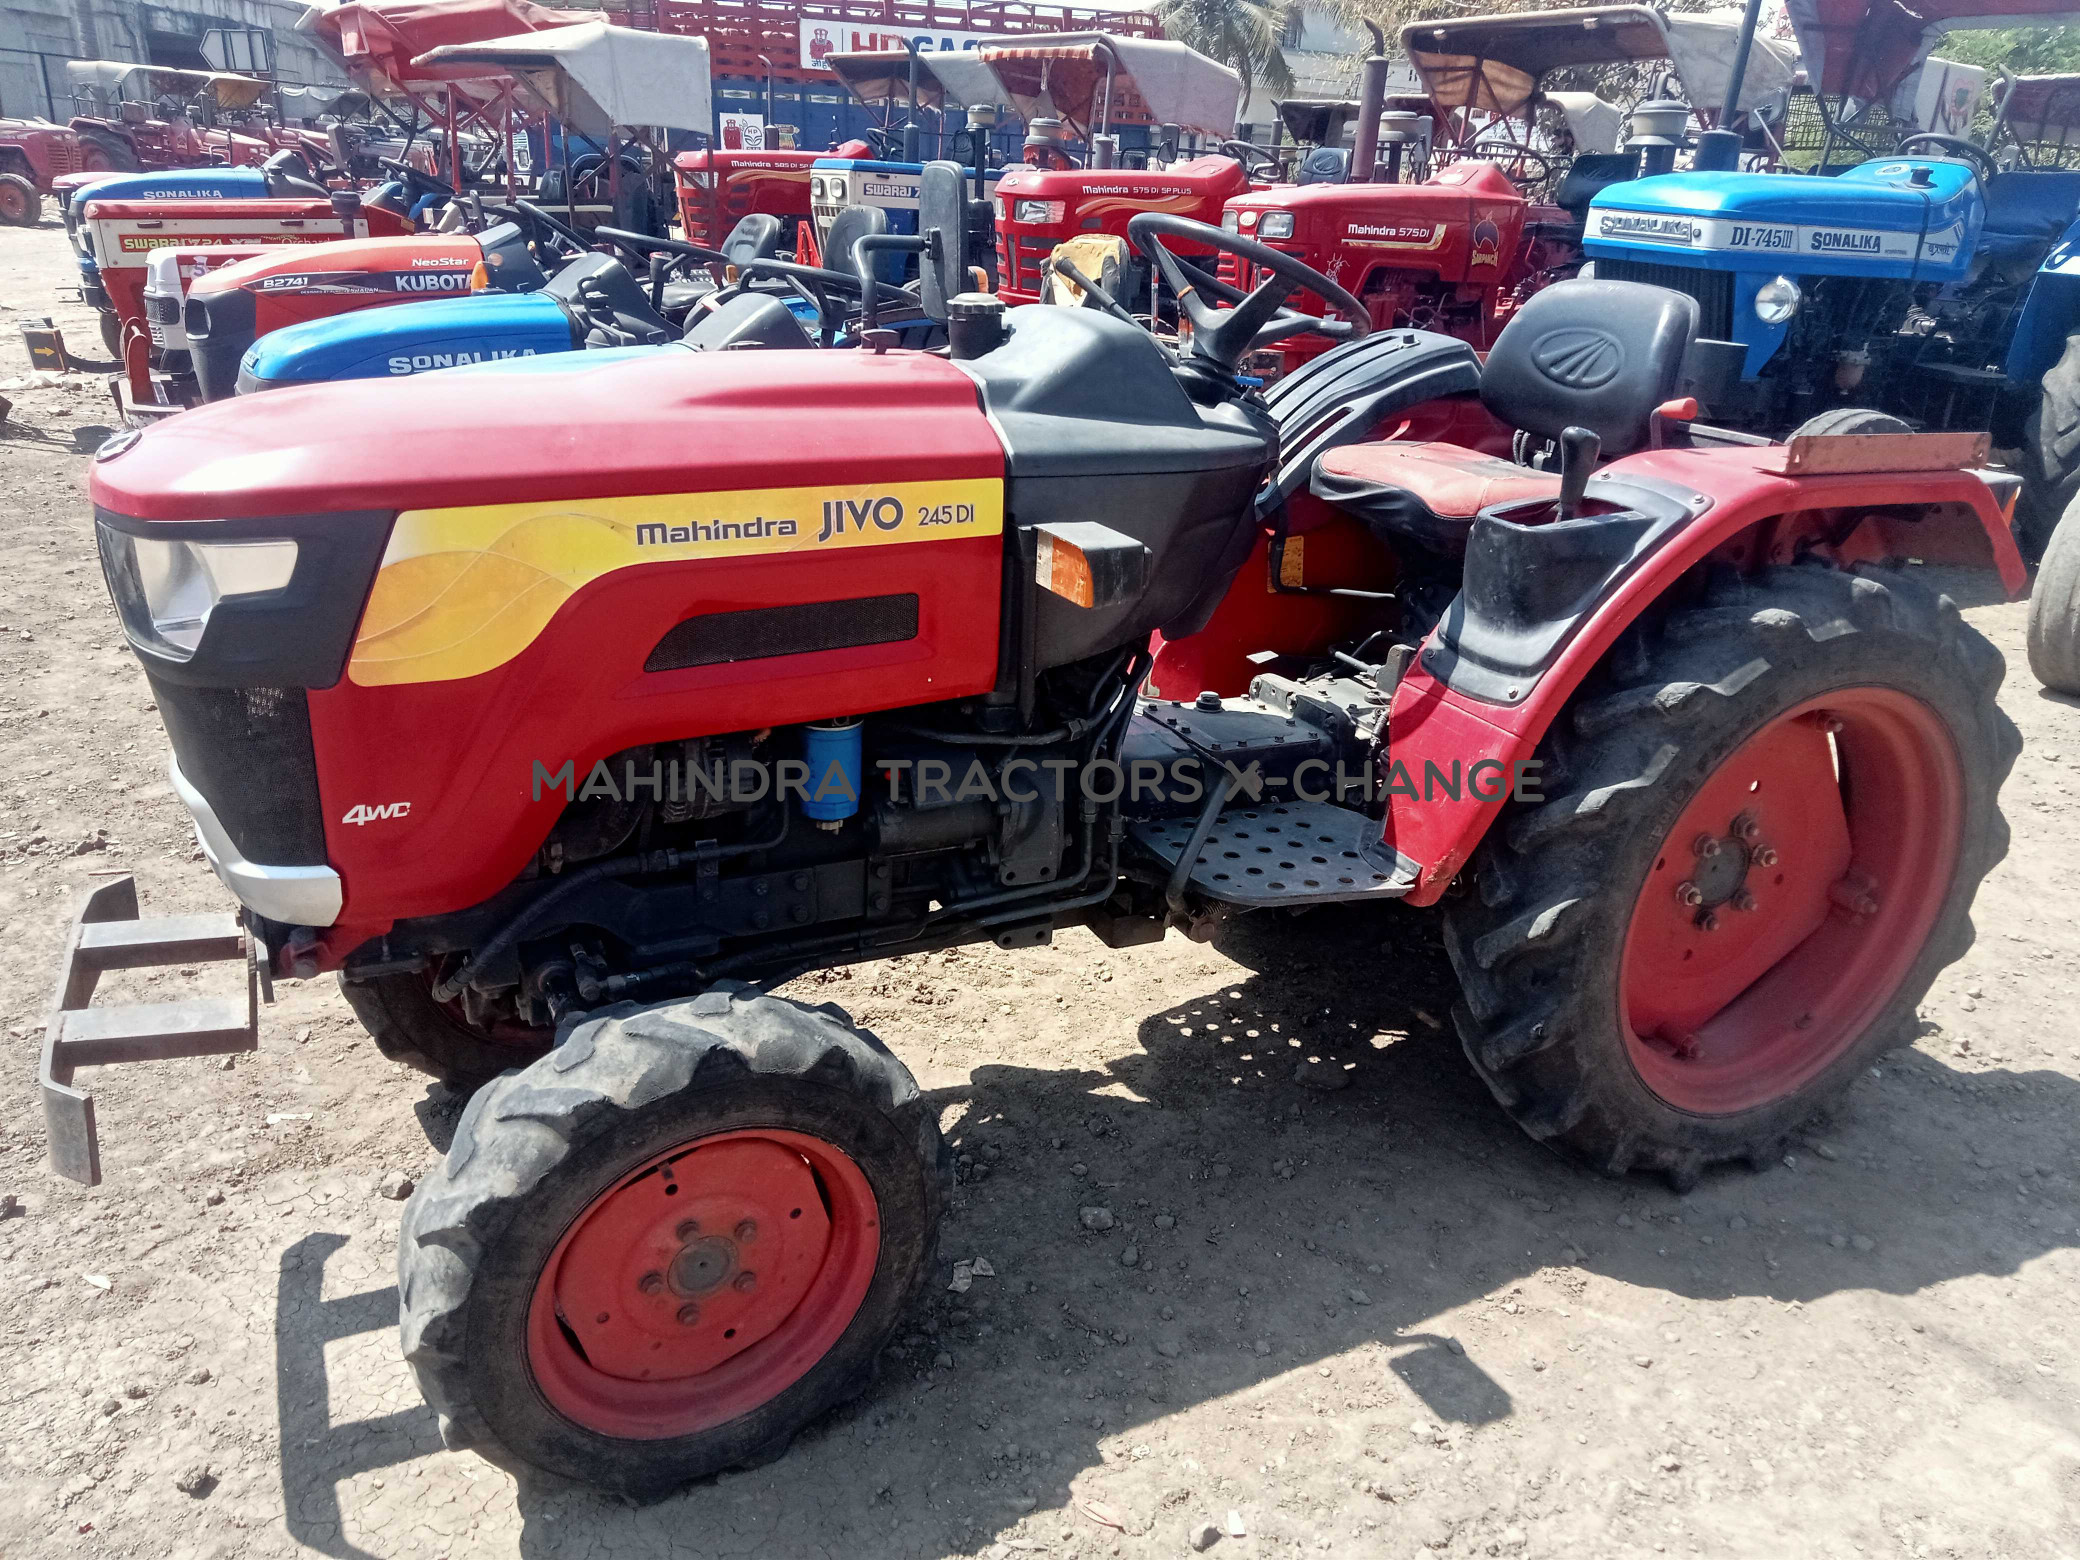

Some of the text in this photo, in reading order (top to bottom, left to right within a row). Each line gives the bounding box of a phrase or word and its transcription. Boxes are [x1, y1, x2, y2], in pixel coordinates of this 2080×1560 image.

[731, 160, 771, 168] Mahindra
[143, 190, 223, 200] SONALIKA
[1082, 185, 1129, 194] Mahindra
[1133, 186, 1150, 194] 575
[1348, 223, 1396, 236] Mahindra
[1600, 215, 1692, 242] SONALIKA
[1811, 231, 1881, 253] SONALIKA
[412, 257, 469, 267] NeoStar
[263, 277, 308, 288] B2741
[395, 274, 472, 292] KUBOTA
[388, 348, 536, 374] SONALIKA
[636, 496, 974, 546] Mahindra JIVO 245 DI
[341, 802, 412, 826] 4WD
